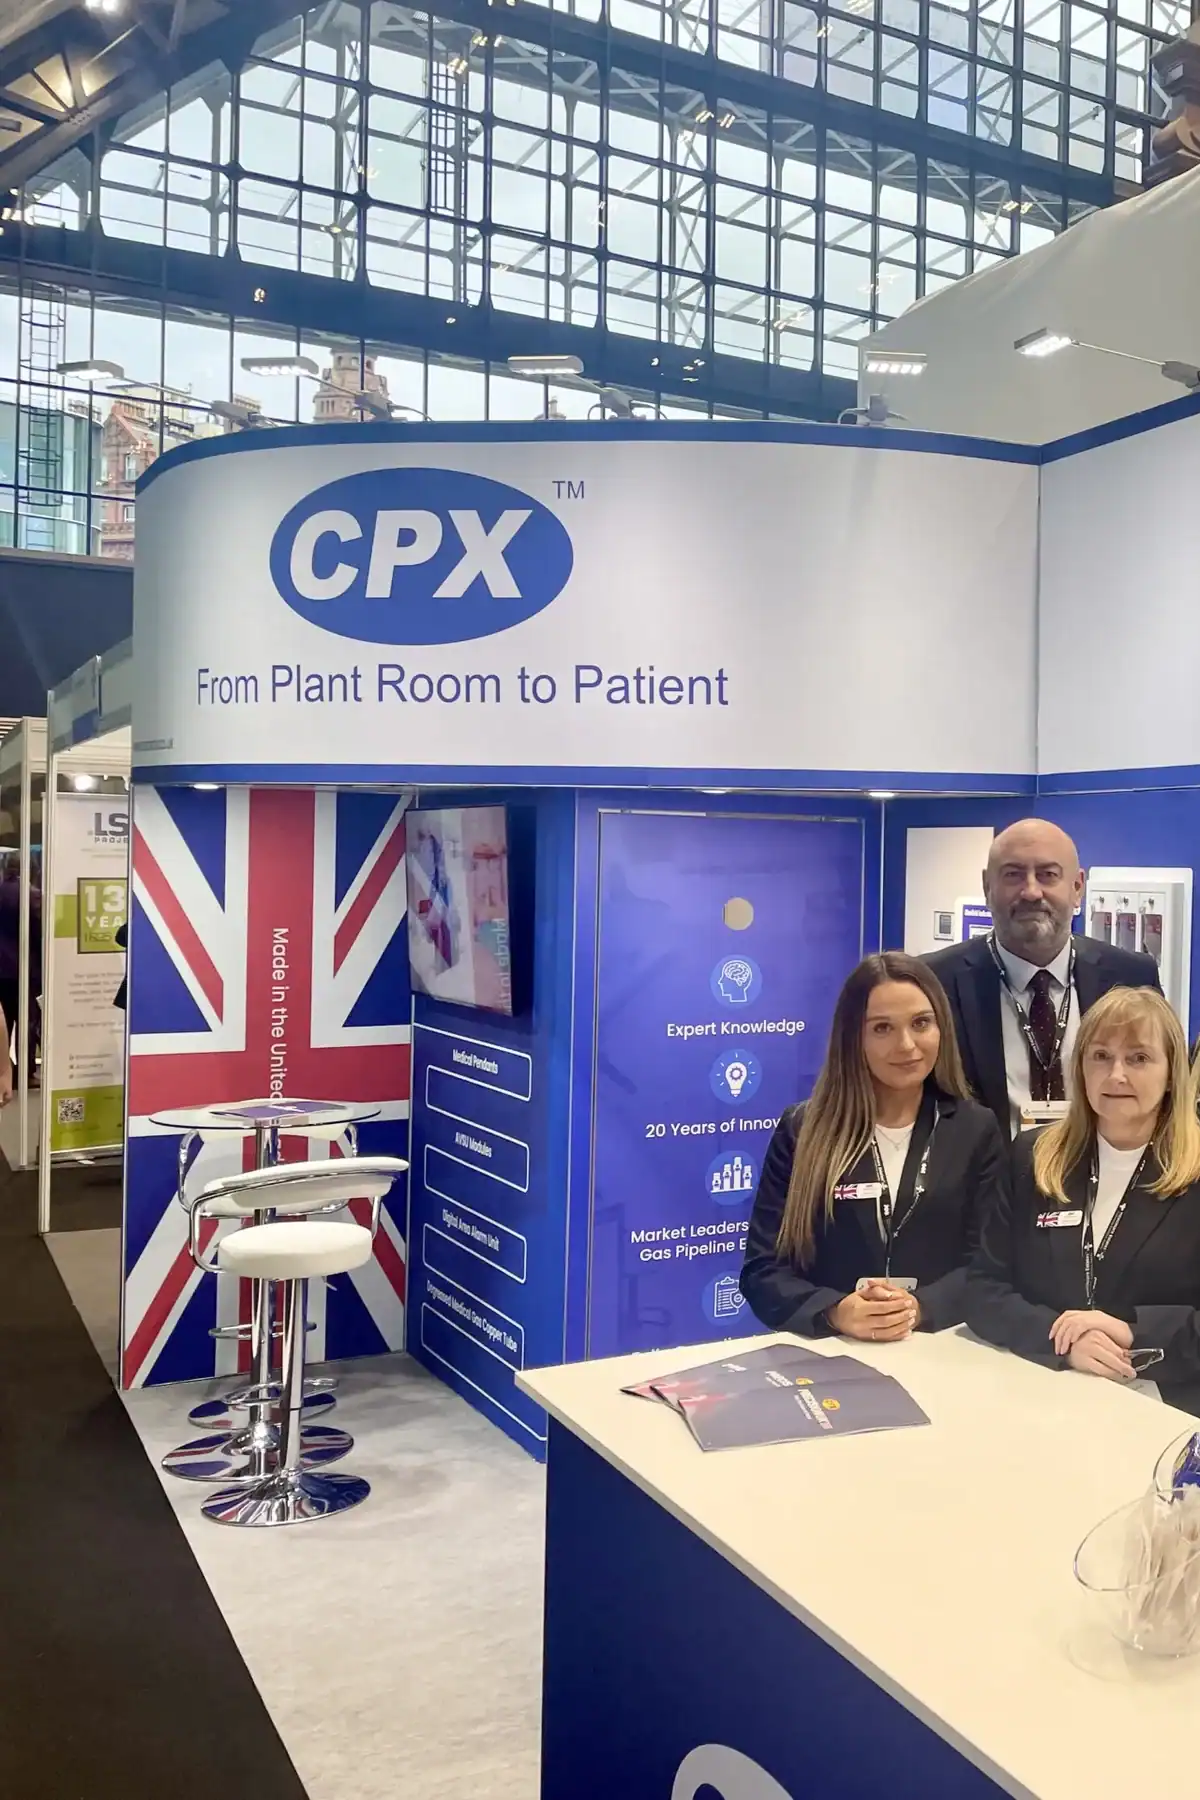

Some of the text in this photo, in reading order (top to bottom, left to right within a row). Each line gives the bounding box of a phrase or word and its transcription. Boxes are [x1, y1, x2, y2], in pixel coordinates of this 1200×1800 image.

[552, 480, 585, 499] TM
[289, 509, 534, 601] CPX
[197, 663, 729, 706] From Plant Room to Patient
[85, 885, 125, 913] 13
[271, 928, 290, 981] Made
[271, 986, 290, 1002] in
[270, 1006, 289, 1038] the
[667, 1019, 806, 1041] Expert Knowledge
[453, 1049, 498, 1074] Medical Pendants
[645, 1116, 781, 1138] 20 Years of Innov
[455, 1131, 492, 1158] AVSU Modules
[443, 1208, 499, 1251] Digital Area Alarm Unit
[631, 1221, 749, 1244] Market Leaders
[640, 1238, 747, 1262] Gas Pipeline E
[451, 1296, 471, 1321] Medical
[471, 1310, 482, 1329] Gas
[482, 1318, 502, 1343] Copper
[502, 1331, 517, 1353] Tube
